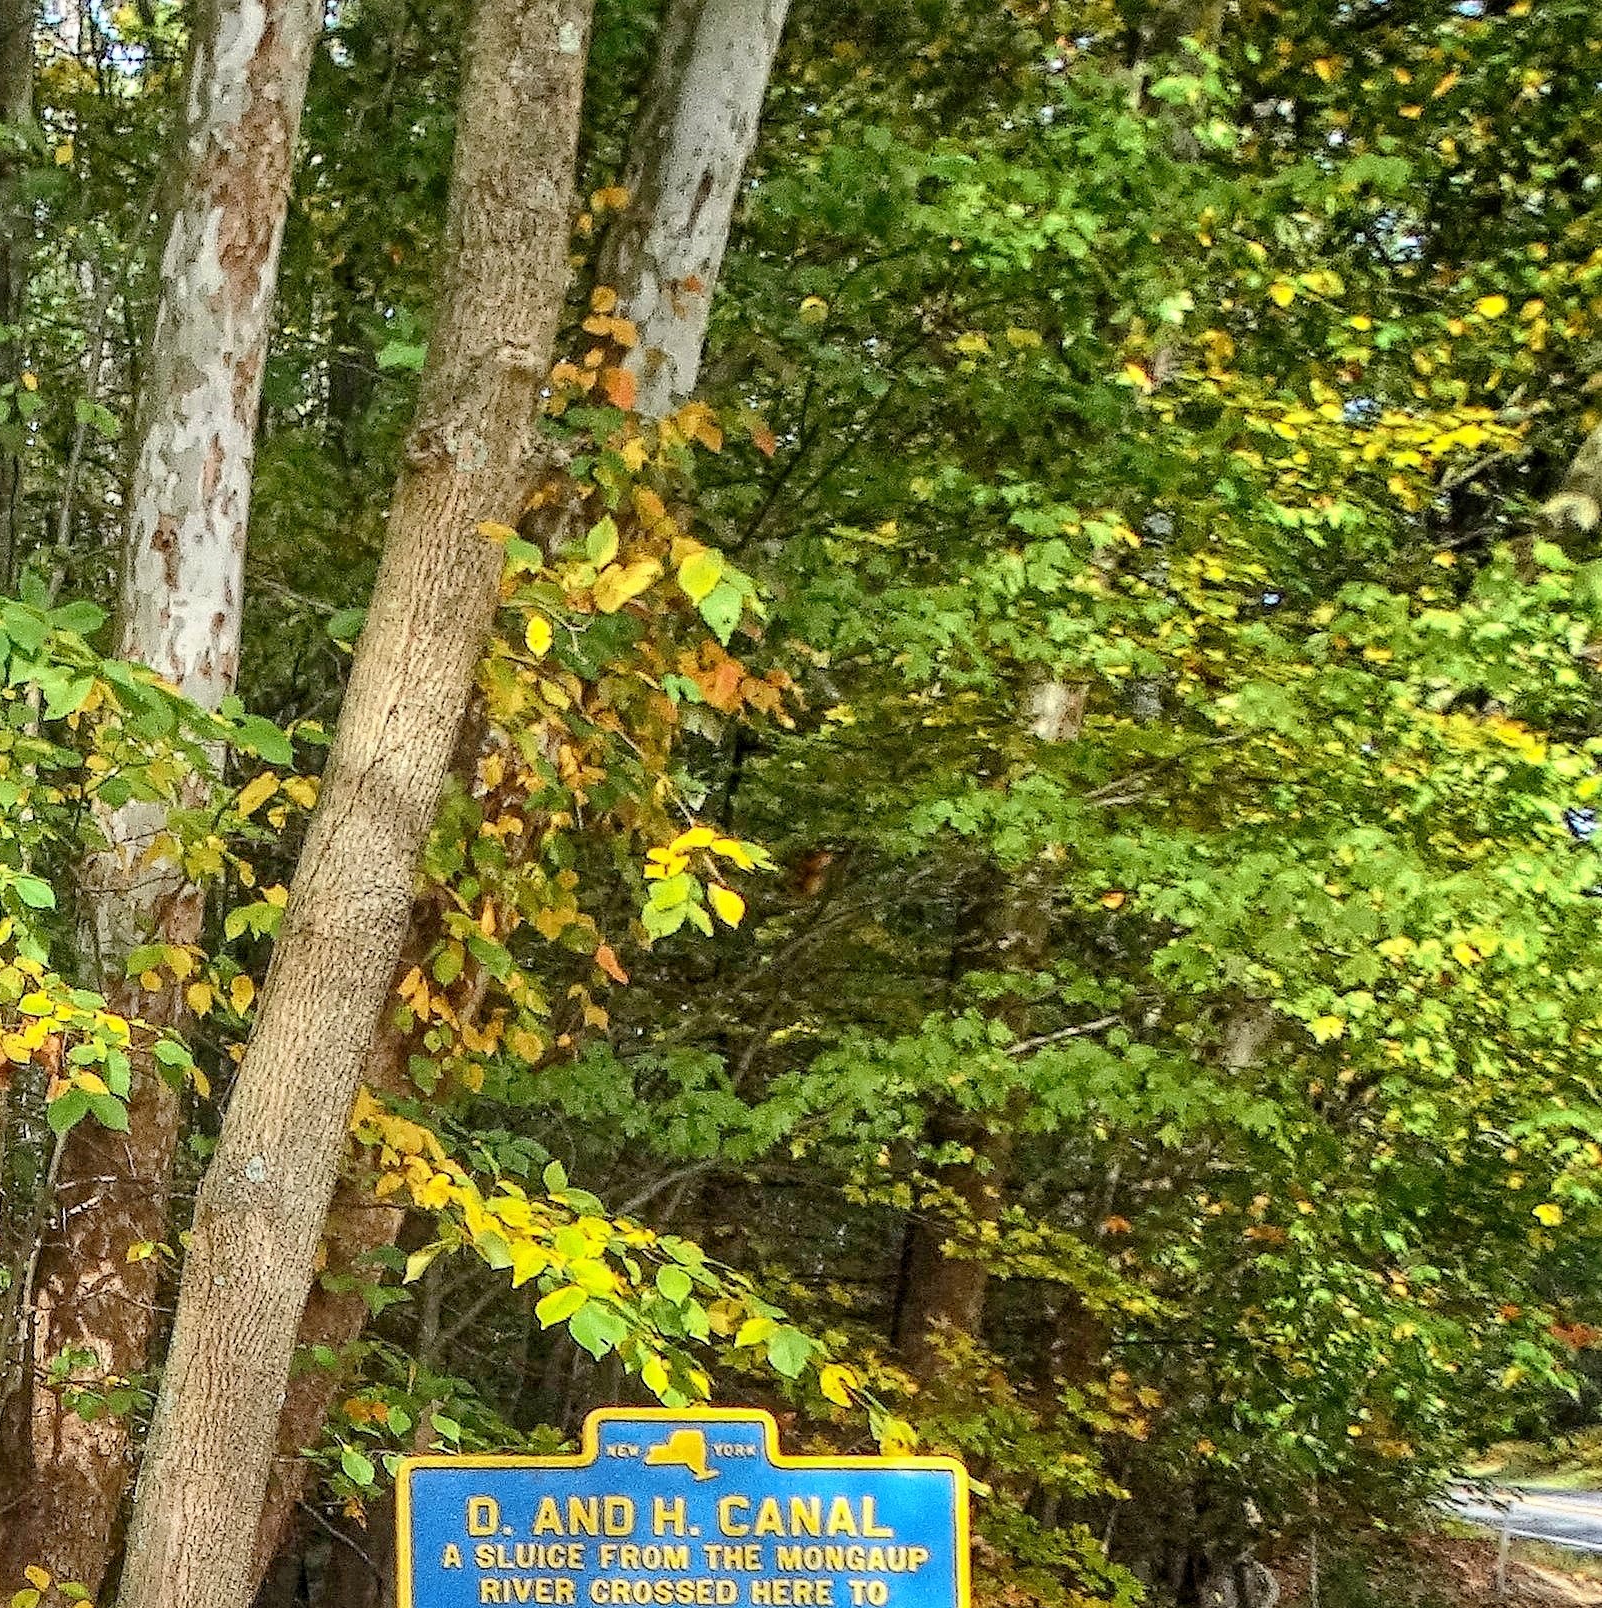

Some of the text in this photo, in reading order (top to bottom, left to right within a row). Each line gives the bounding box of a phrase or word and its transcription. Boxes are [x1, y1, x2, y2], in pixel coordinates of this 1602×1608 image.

[606, 1443, 757, 1457] NEW YORK
[467, 1496, 894, 1538] D. AND H. CANAL
[442, 1545, 930, 1574] A SLUICE FROM THE MONGAUP
[480, 1580, 889, 1606] RIVER CROSSED HERE TO
